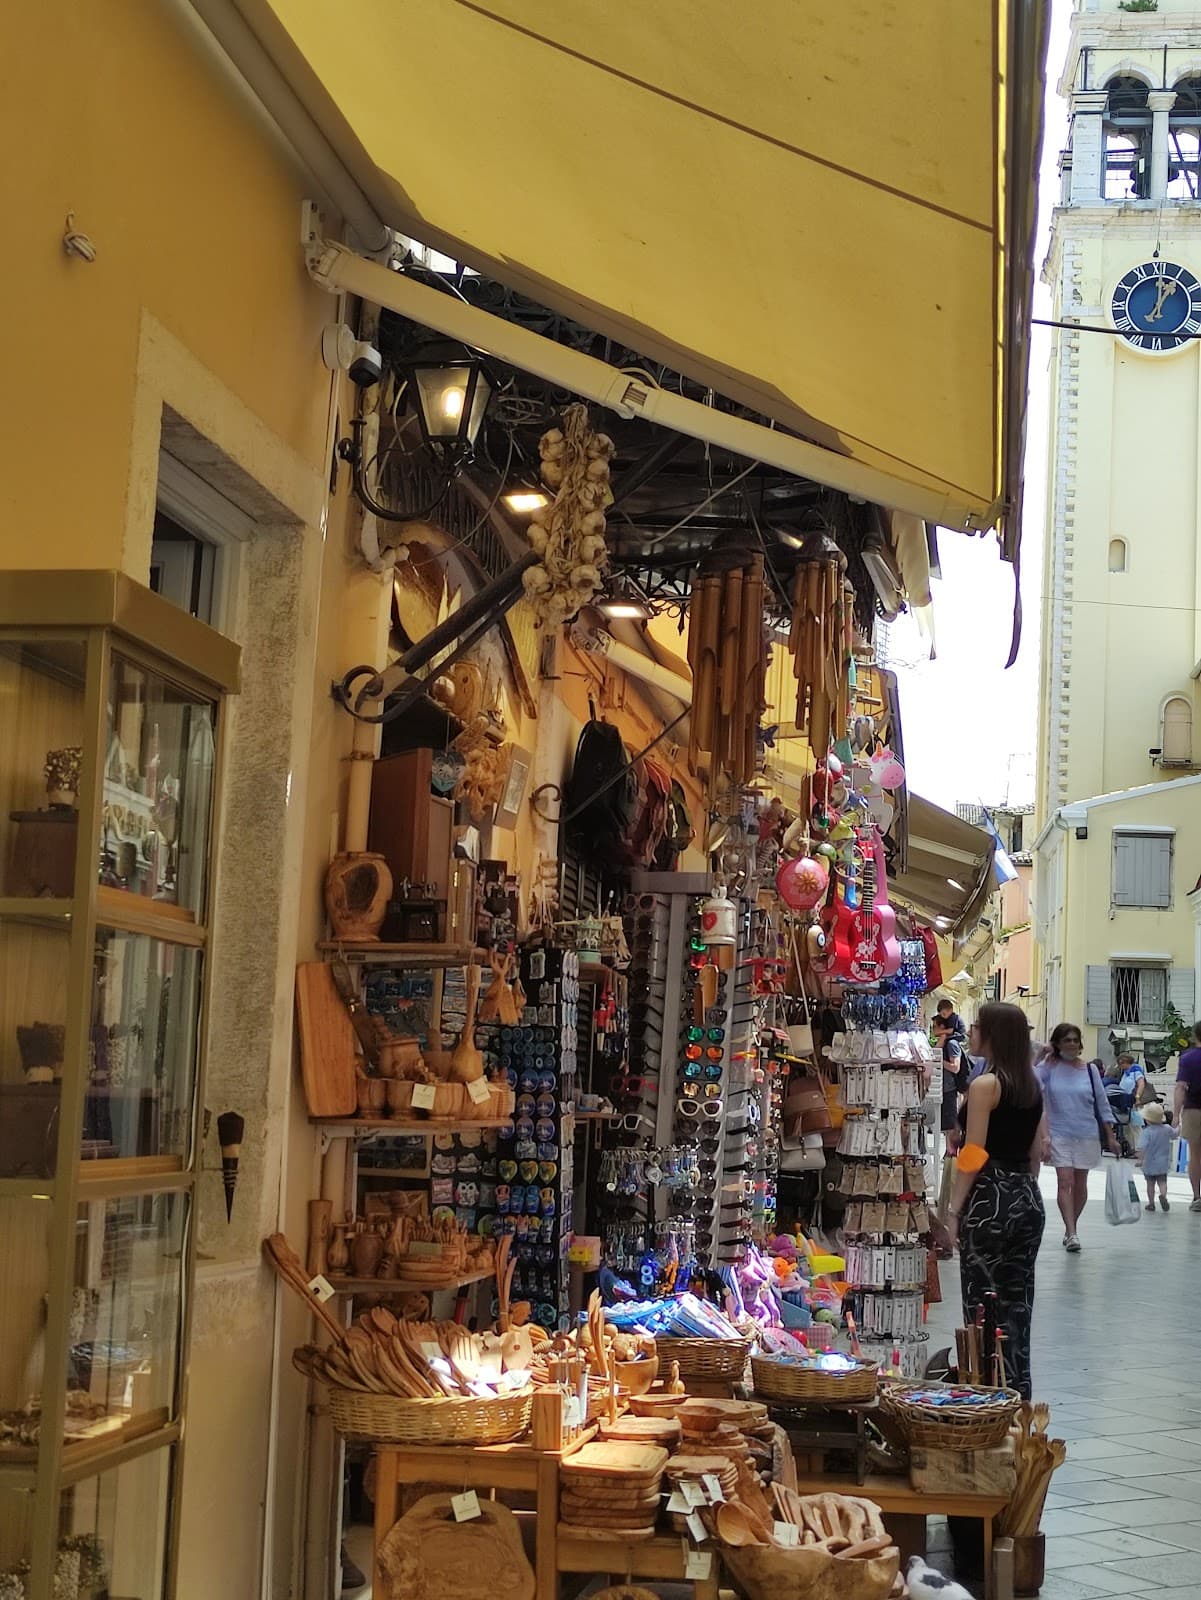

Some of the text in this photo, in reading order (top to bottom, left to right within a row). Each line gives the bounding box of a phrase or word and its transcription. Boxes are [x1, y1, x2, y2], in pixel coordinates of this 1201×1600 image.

[1133, 266, 1147, 281] XI
[1152, 262, 1167, 275] XII
[1175, 268, 1184, 280] I
[1118, 282, 1131, 293] X
[1187, 282, 1201, 293] II
[1112, 300, 1125, 310] IX
